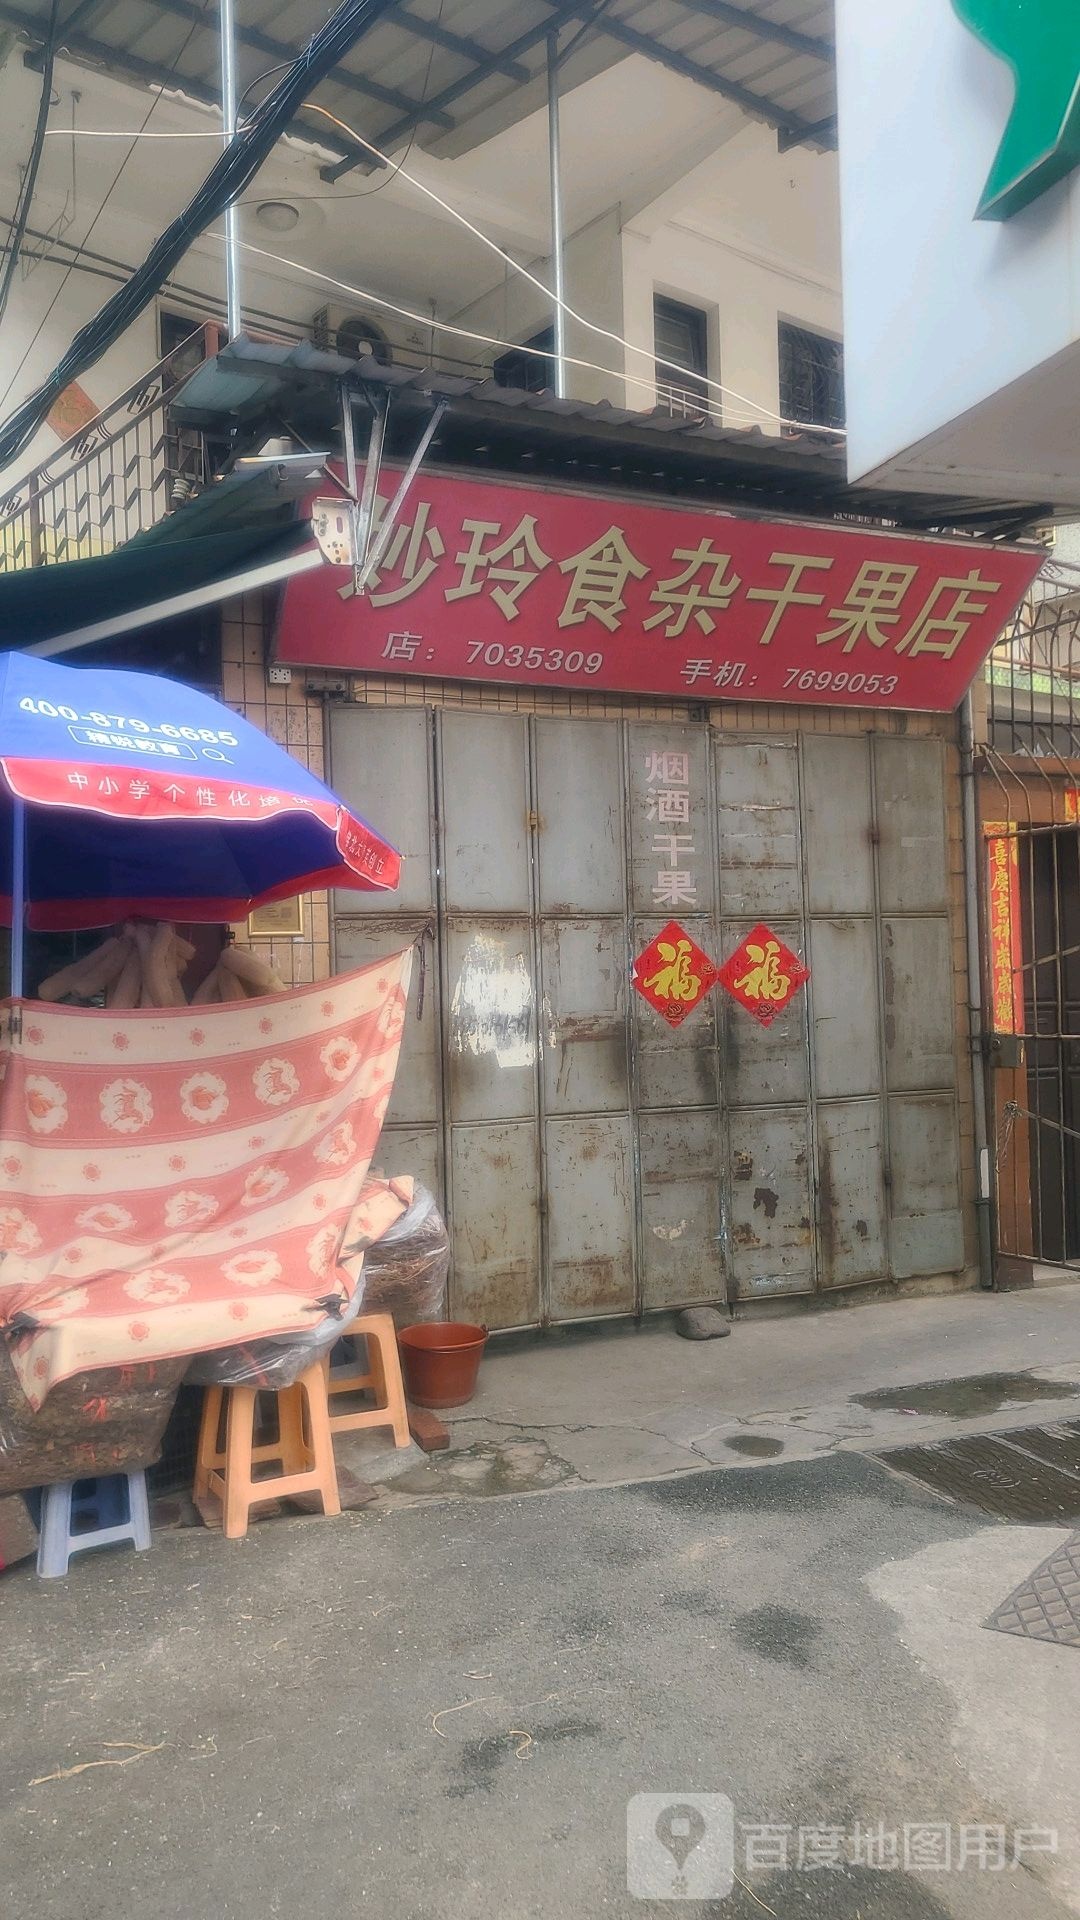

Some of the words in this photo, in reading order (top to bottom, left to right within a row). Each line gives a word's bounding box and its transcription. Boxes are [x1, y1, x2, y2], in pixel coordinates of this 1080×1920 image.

[466, 640, 603, 674] 7035309
[679, 659, 758, 688] 手机：
[781, 668, 899, 695] 7699053
[19, 698, 239, 748] 400-879-6685
[645, 751, 697, 905] 烟酒干果
[643, 939, 702, 1001] 福
[733, 940, 791, 1001] 福
